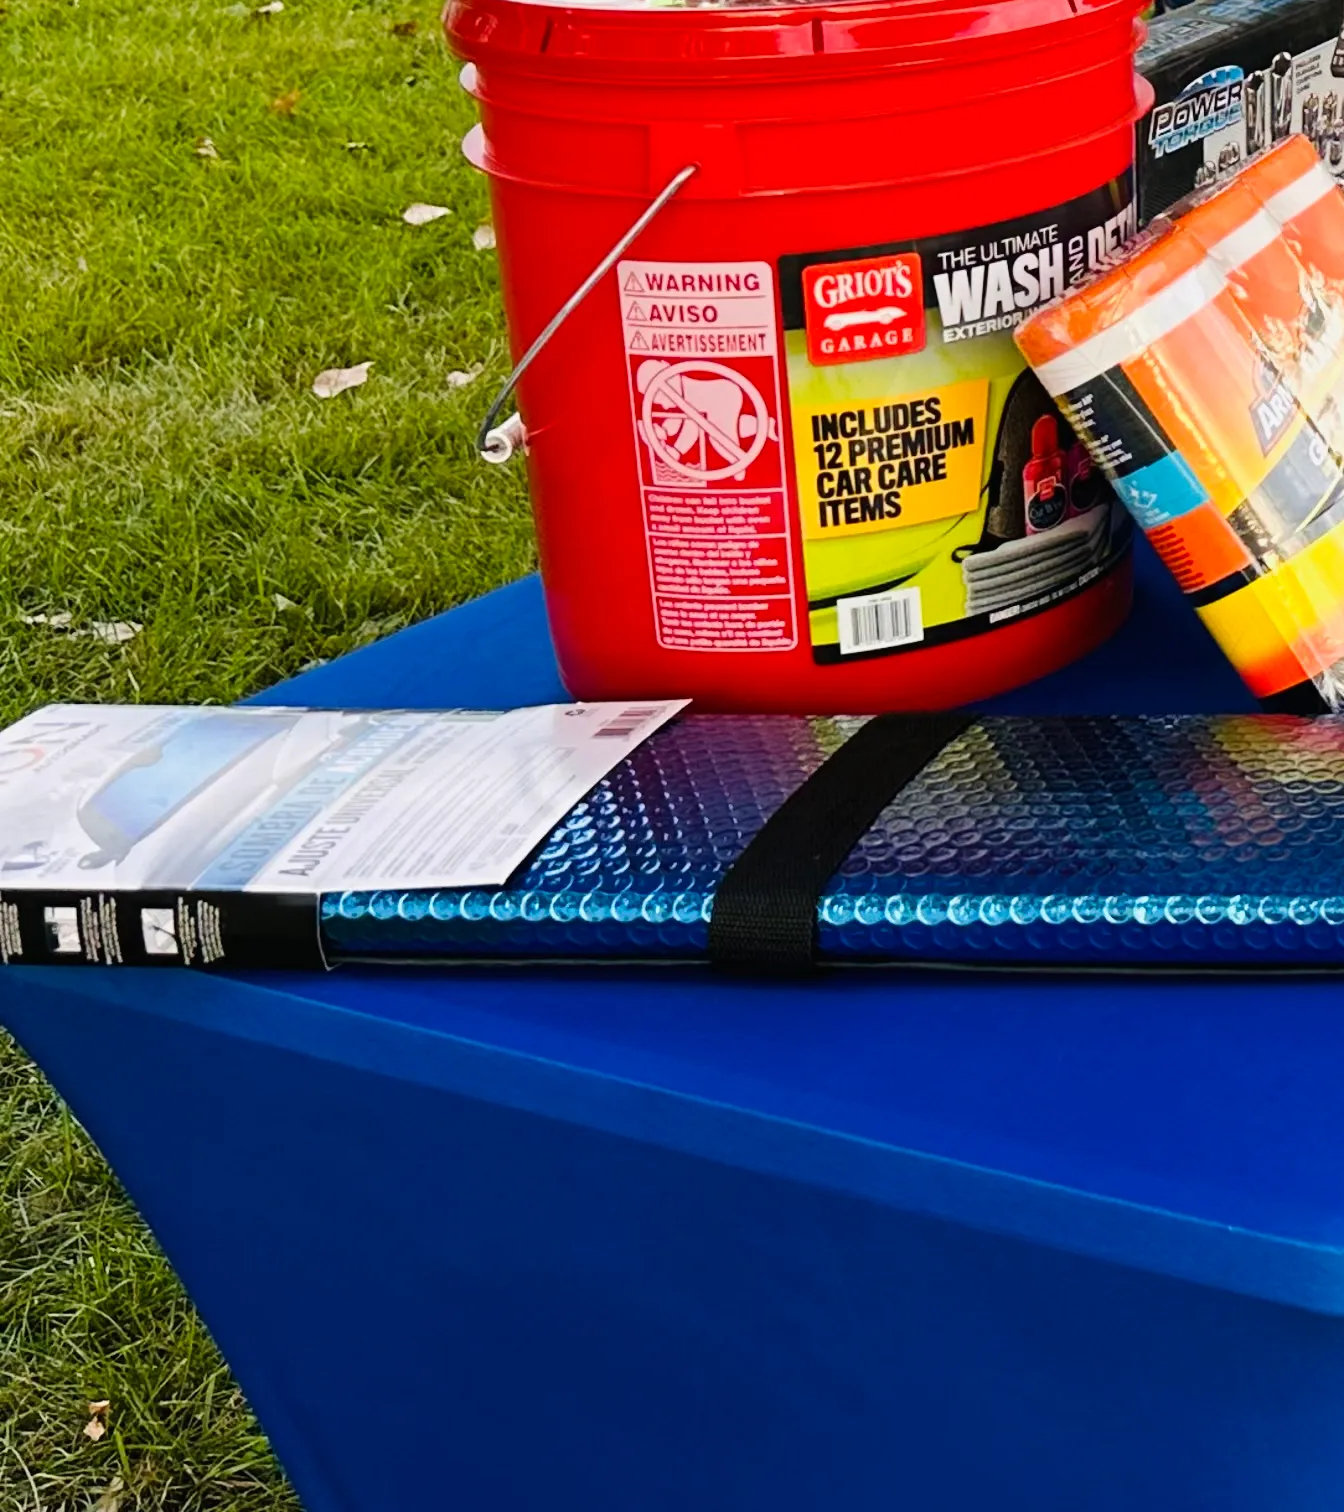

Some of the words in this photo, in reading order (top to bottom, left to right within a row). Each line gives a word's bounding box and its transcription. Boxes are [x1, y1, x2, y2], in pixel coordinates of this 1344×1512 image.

[1148, 80, 1246, 146] POWER
[1152, 104, 1246, 159] TORQUE
[937, 246, 977, 271] THE
[979, 223, 1060, 263] ULTIMATE
[645, 273, 761, 293] WARNING
[813, 259, 914, 309] GRIOT'S
[932, 243, 1065, 328] WASH
[1067, 235, 1086, 288] AND
[649, 304, 719, 323] AVISO
[651, 333, 767, 353] AVERTISSEMENT
[819, 327, 915, 355] GARAGE
[811, 396, 942, 443] INCLUDES
[813, 442, 844, 471] 12
[848, 417, 975, 467] PREMIUM
[816, 466, 874, 500] CAR
[877, 452, 948, 491] CARE
[818, 490, 902, 529] ITEMS
[218, 797, 323, 874] SOMBRA
[295, 776, 346, 796] DE
[277, 826, 353, 878] AJUSTE
[324, 765, 418, 825] UNIVERSAL
